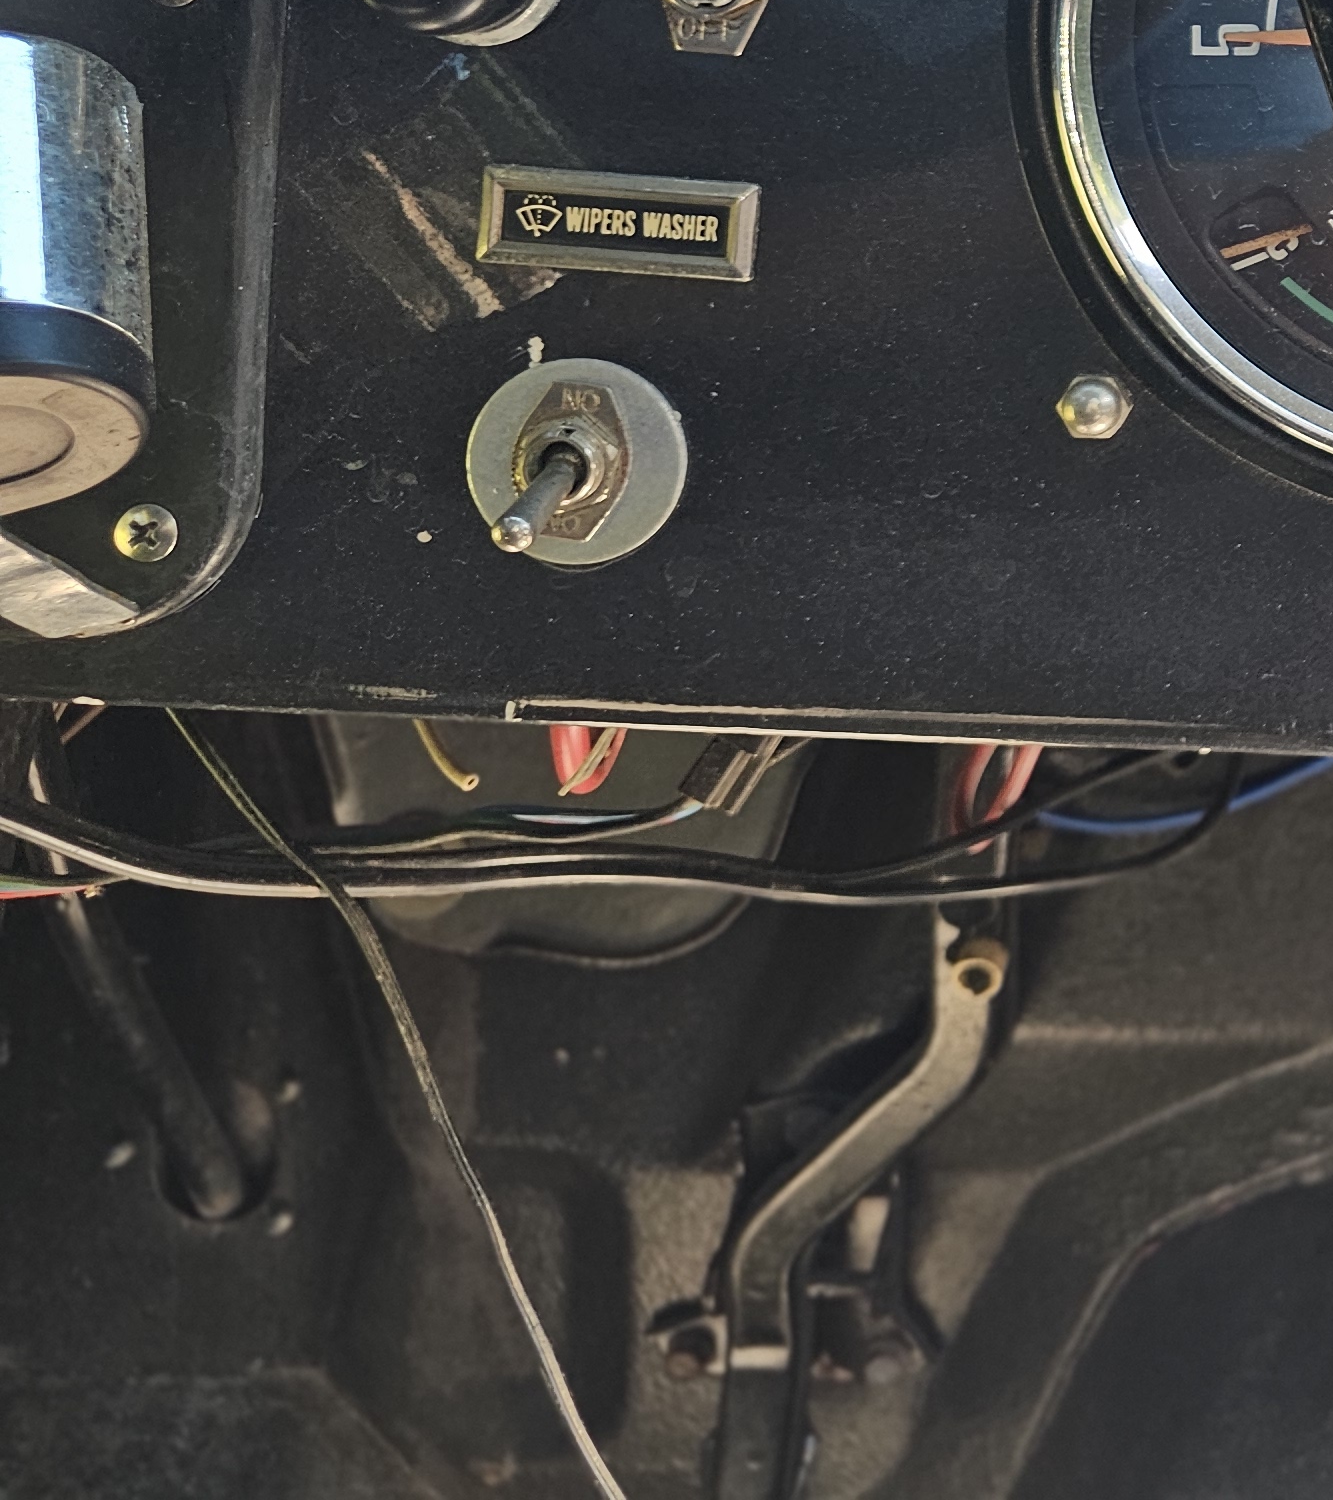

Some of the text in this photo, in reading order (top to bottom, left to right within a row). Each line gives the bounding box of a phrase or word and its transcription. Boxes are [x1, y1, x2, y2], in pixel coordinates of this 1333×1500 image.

[1191, 23, 1261, 56] 5
[565, 206, 718, 243] WIPERS WASHER
[1266, 236, 1299, 261] C
